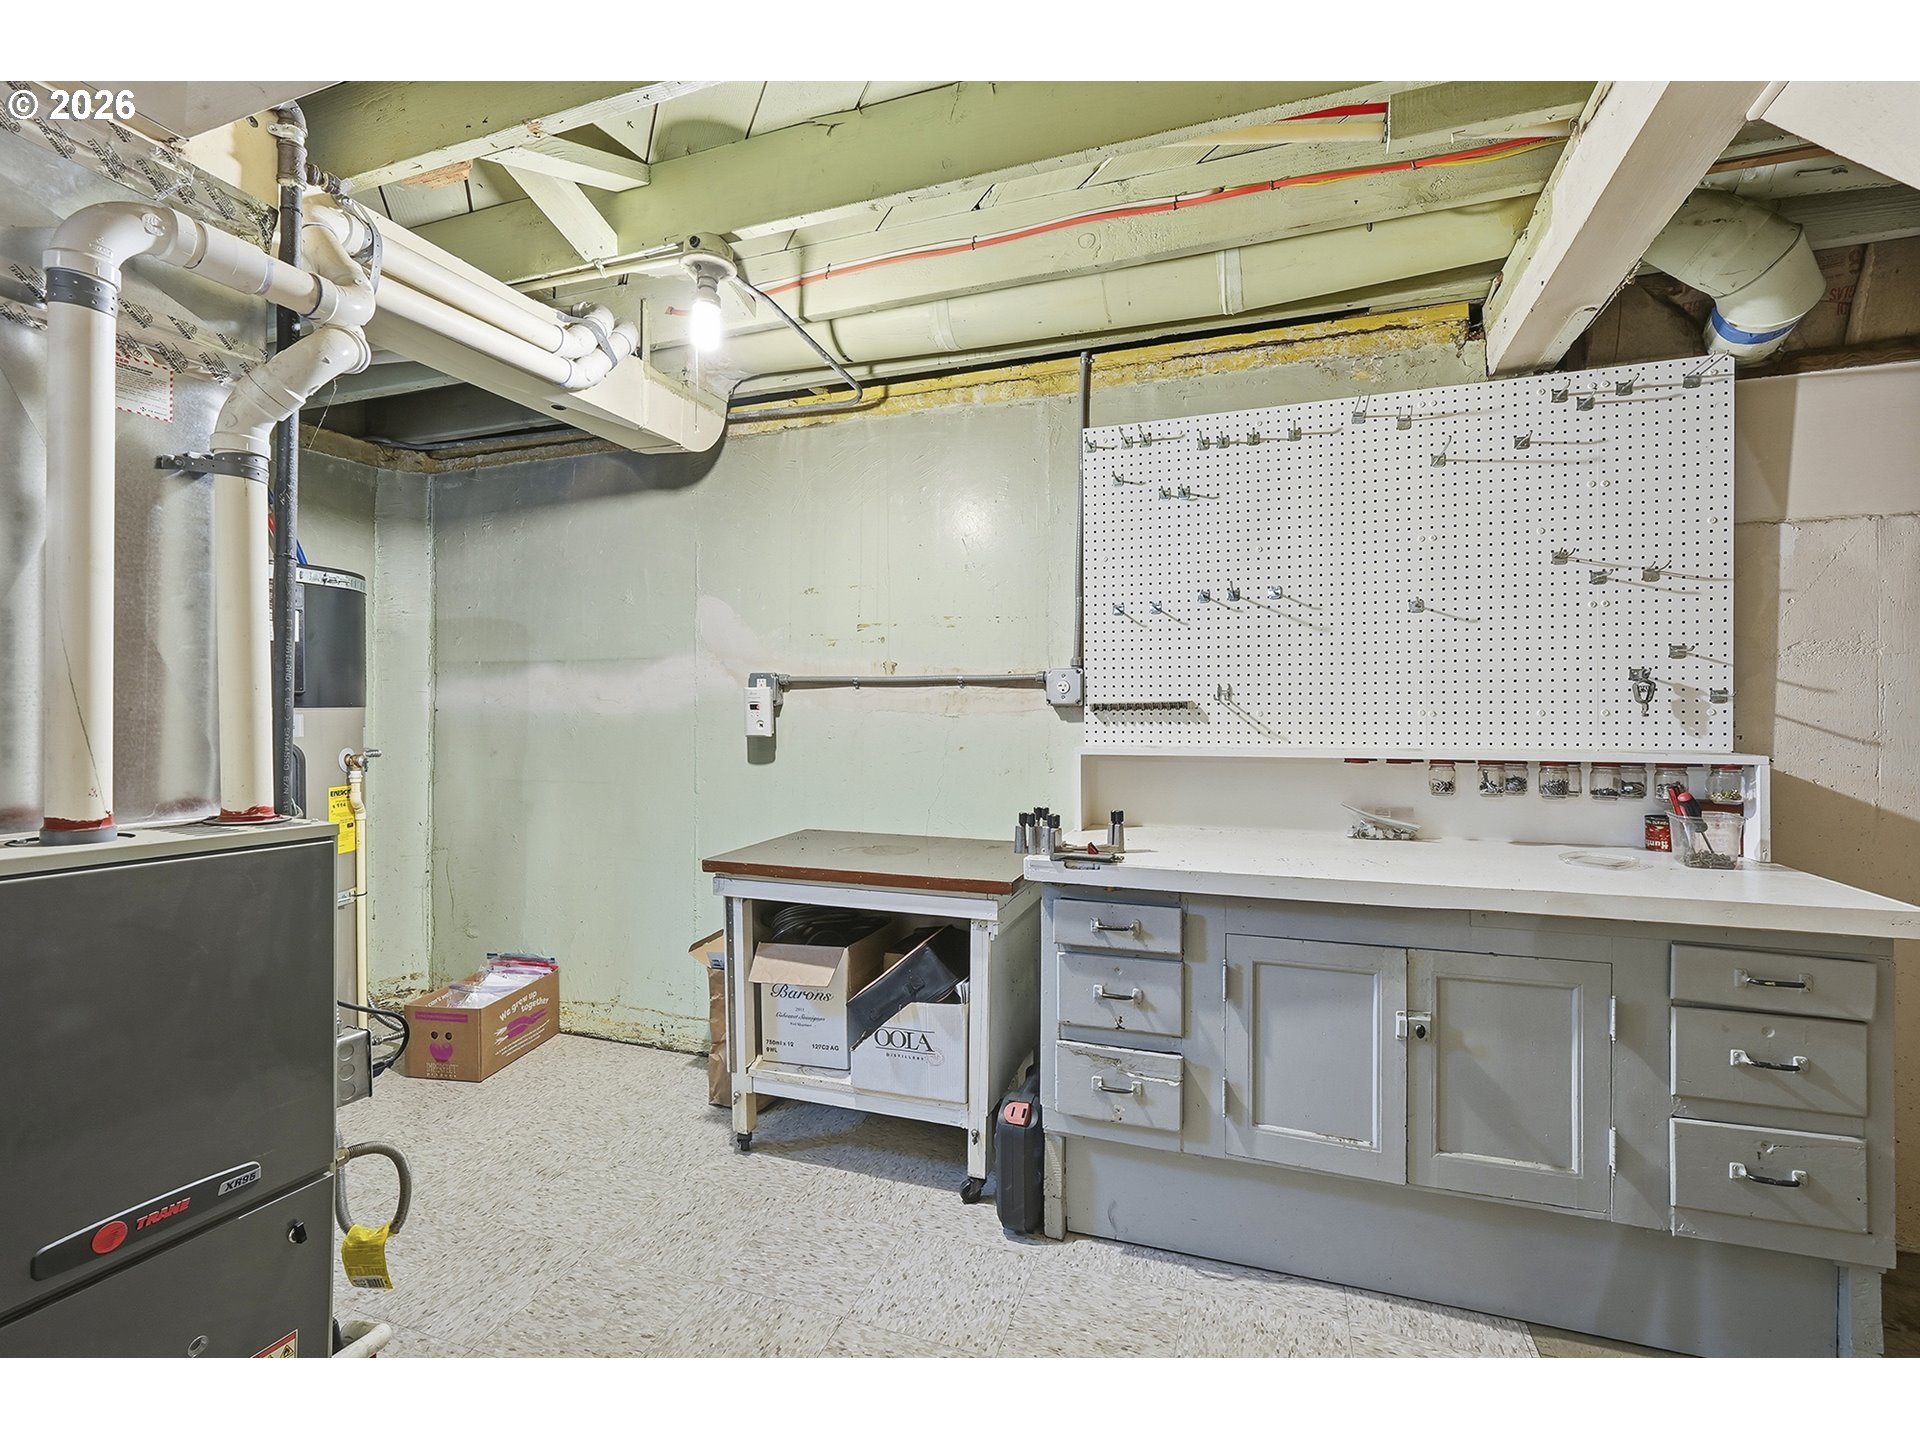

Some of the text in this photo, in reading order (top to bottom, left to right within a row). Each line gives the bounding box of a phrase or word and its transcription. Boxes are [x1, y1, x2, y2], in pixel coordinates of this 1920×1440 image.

[770, 983, 834, 1001] Barons
[499, 991, 538, 1021] We grew up
[521, 996, 549, 1012] together
[874, 1028, 935, 1052] OOLA
[224, 1171, 256, 1192] XR95
[137, 1196, 191, 1231] TRANE
